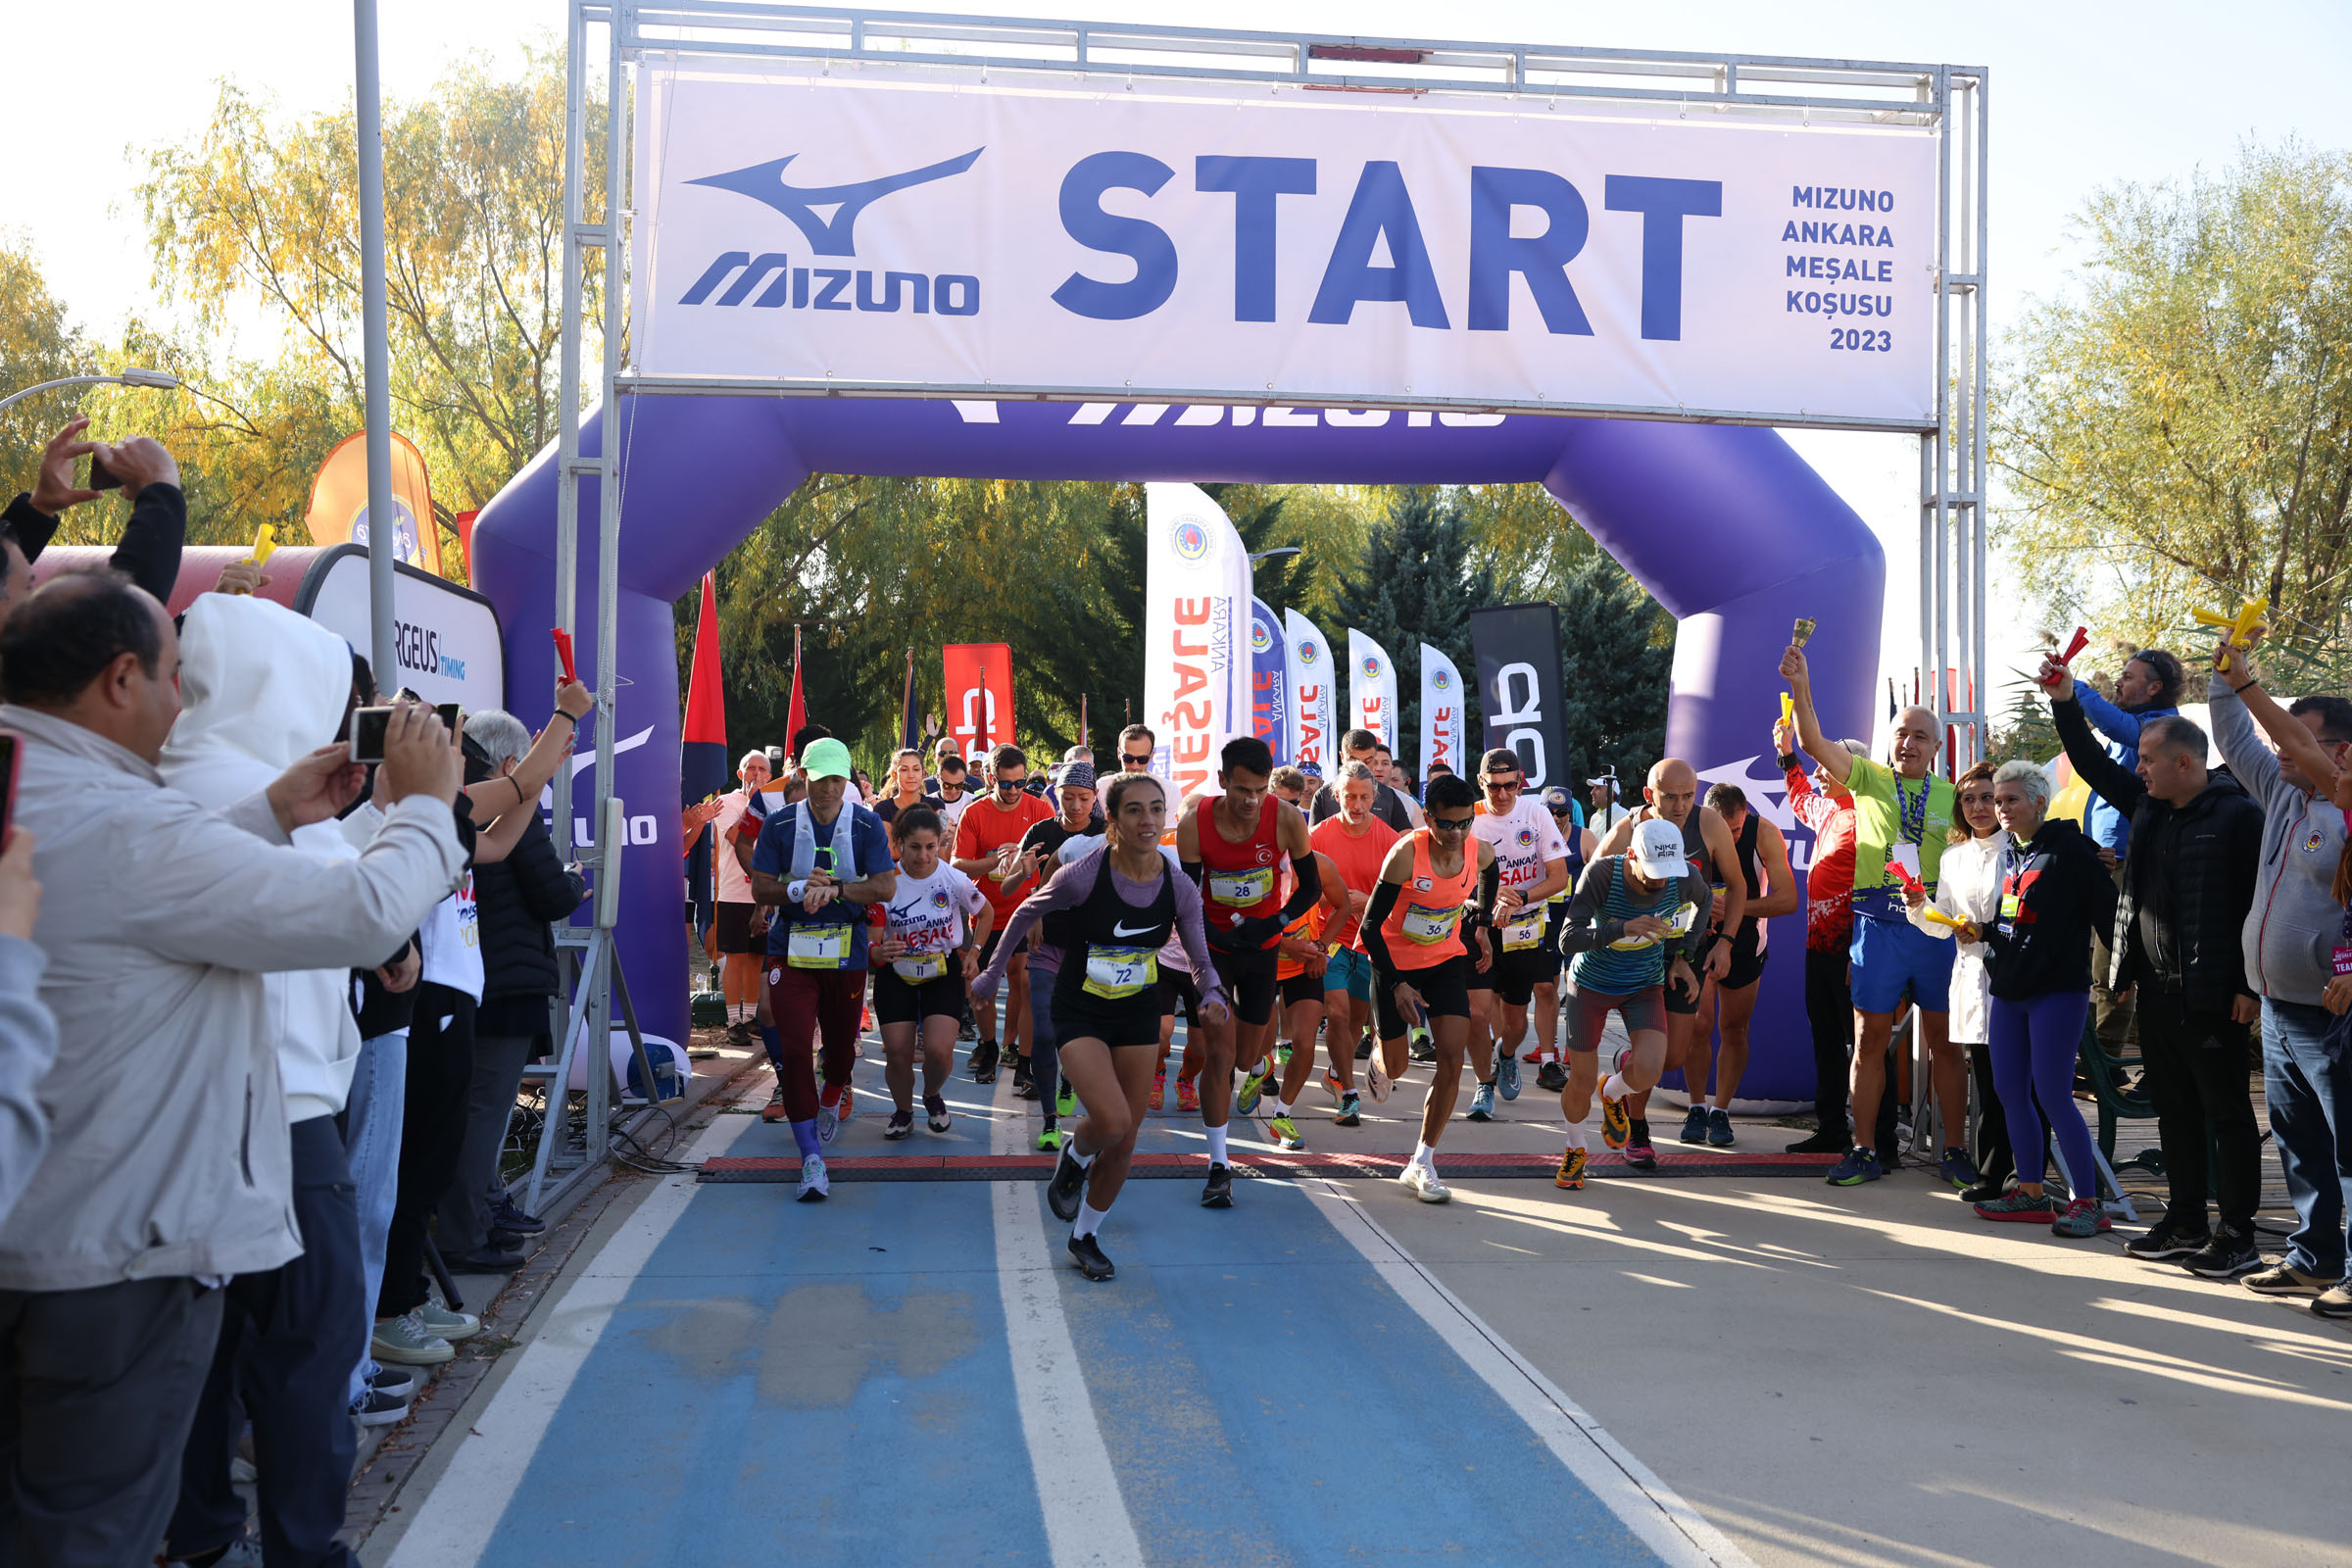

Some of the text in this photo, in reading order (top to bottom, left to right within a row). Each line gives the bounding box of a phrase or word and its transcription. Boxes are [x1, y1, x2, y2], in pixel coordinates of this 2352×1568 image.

[1792, 185, 1894, 213] MIZUNO
[1051, 151, 1722, 341] START
[1782, 220, 1894, 248] ANKARA
[1787, 255, 1892, 285] MEŞALE
[677, 251, 980, 317] MIZUNO
[1787, 290, 1892, 320] KOŞUSU
[1830, 328, 1891, 353] 2023
[395, 619, 466, 681] RGEUS TIMING
[1654, 843, 1678, 852] NIKE
[1235, 886, 1250, 898] 28
[1426, 924, 1442, 935] 36
[1519, 929, 1531, 940] 56
[818, 942, 823, 956] 1
[915, 965, 924, 977] 11
[1114, 967, 1132, 985] 72
